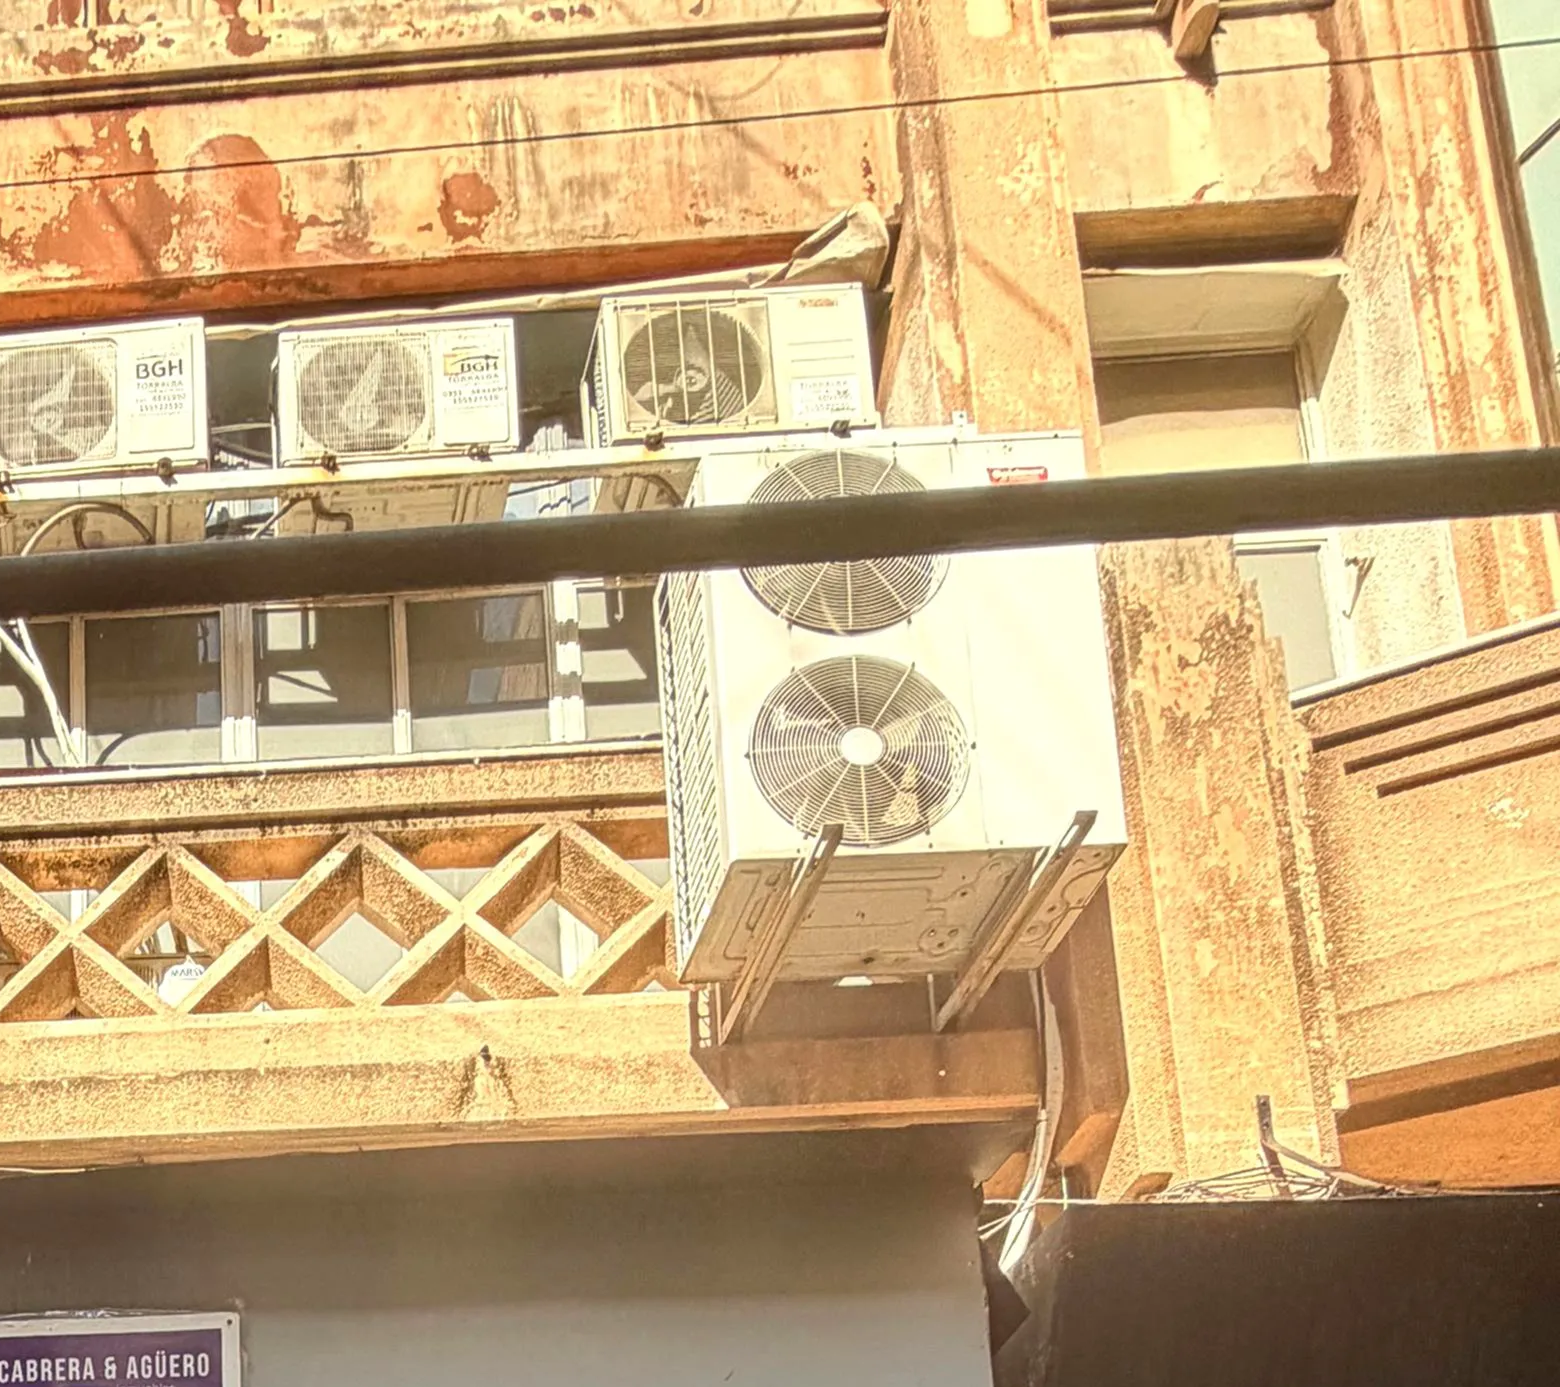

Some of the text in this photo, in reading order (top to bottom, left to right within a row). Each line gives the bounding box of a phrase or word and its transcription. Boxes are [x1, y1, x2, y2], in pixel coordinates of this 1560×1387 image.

[136, 358, 183, 379] BGH
[460, 361, 499, 374] BGH
[104, 1355, 117, 1380] &
[126, 1350, 210, 1380] AGÜERO
